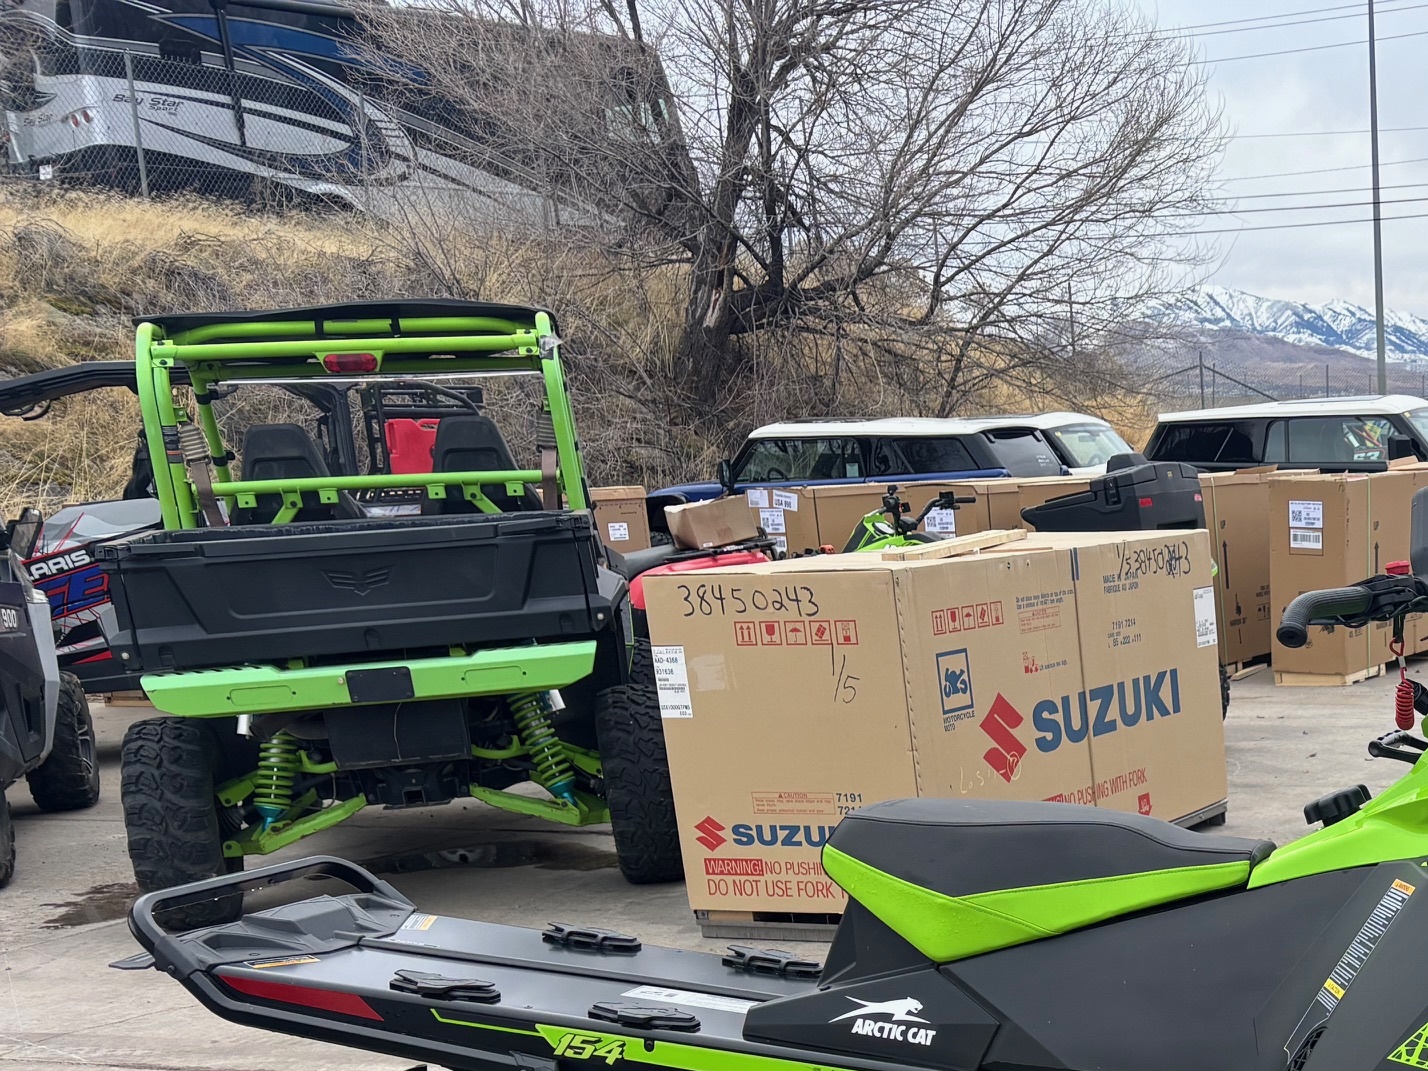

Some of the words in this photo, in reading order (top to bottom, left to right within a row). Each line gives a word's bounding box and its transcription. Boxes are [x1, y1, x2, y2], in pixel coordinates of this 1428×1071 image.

[149, 97, 184, 107] Star
[29, 549, 92, 581] ARIS
[1103, 574, 1116, 584] MADE
[677, 584, 819, 617] 38450243
[1, 608, 18, 629] 900
[831, 643, 860, 703] 1/5
[943, 710, 976, 725] MOTORCYCLE
[1032, 668, 1181, 753] SUZUKI
[944, 723, 956, 733] MOTO
[1077, 780, 1110, 805] PUSHING
[1109, 774, 1128, 795] WITH
[1128, 767, 1148, 788] FORK
[836, 793, 863, 803] 7191
[705, 860, 763, 875] WARNING!
[764, 861, 782, 875] NO
[707, 878, 729, 896] DO
[732, 879, 761, 897] NOT
[765, 880, 794, 897] USE
[796, 880, 836, 899] FORK
[851, 1018, 906, 1041] ARCTIC
[907, 1027, 937, 1046] CAT
[553, 1032, 626, 1066] 154
